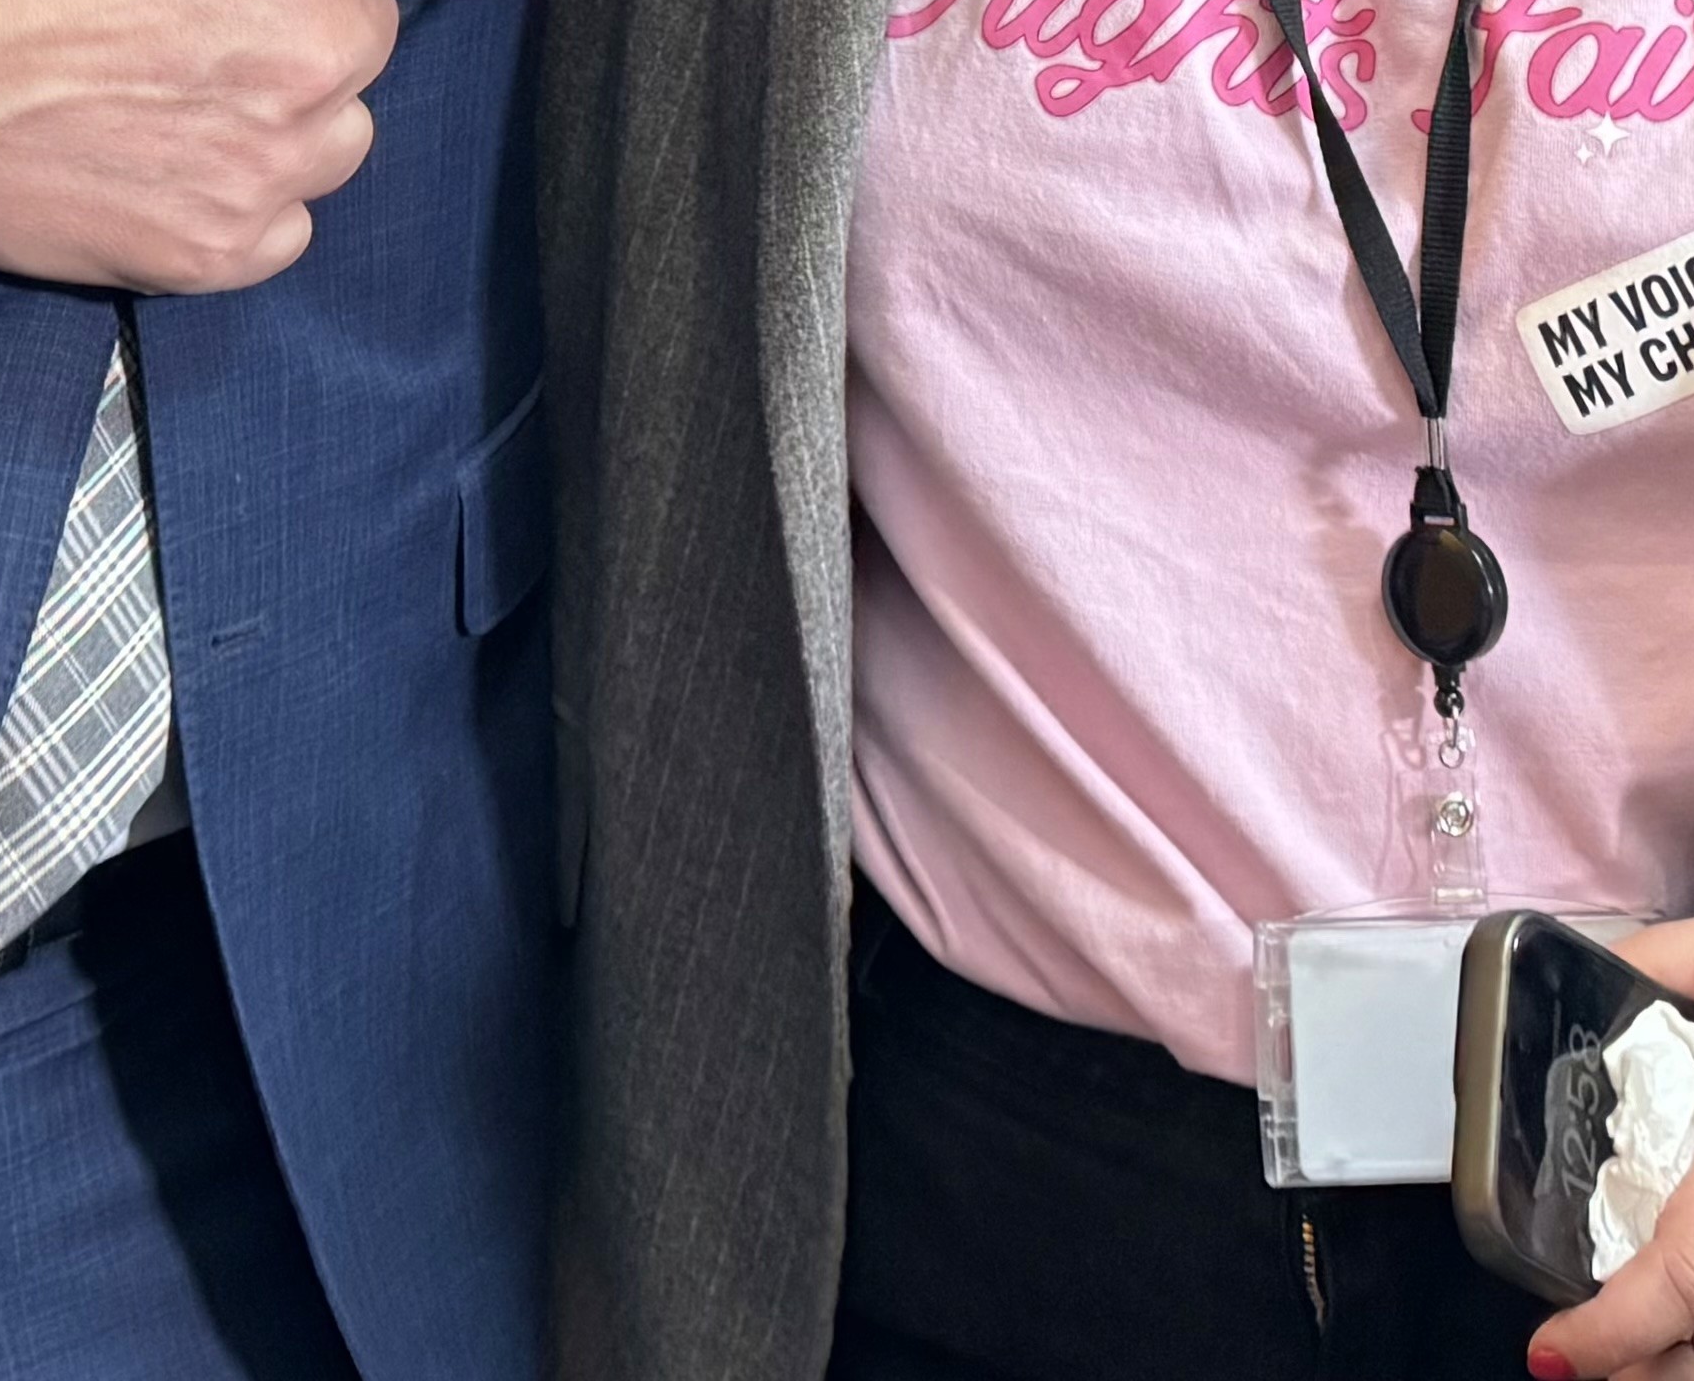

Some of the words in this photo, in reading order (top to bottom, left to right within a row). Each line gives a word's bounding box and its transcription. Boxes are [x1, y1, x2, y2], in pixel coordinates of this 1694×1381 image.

[1537, 298, 1608, 368] MY
[1562, 350, 1636, 418] MY
[1562, 1023, 1601, 1198] 12:58
